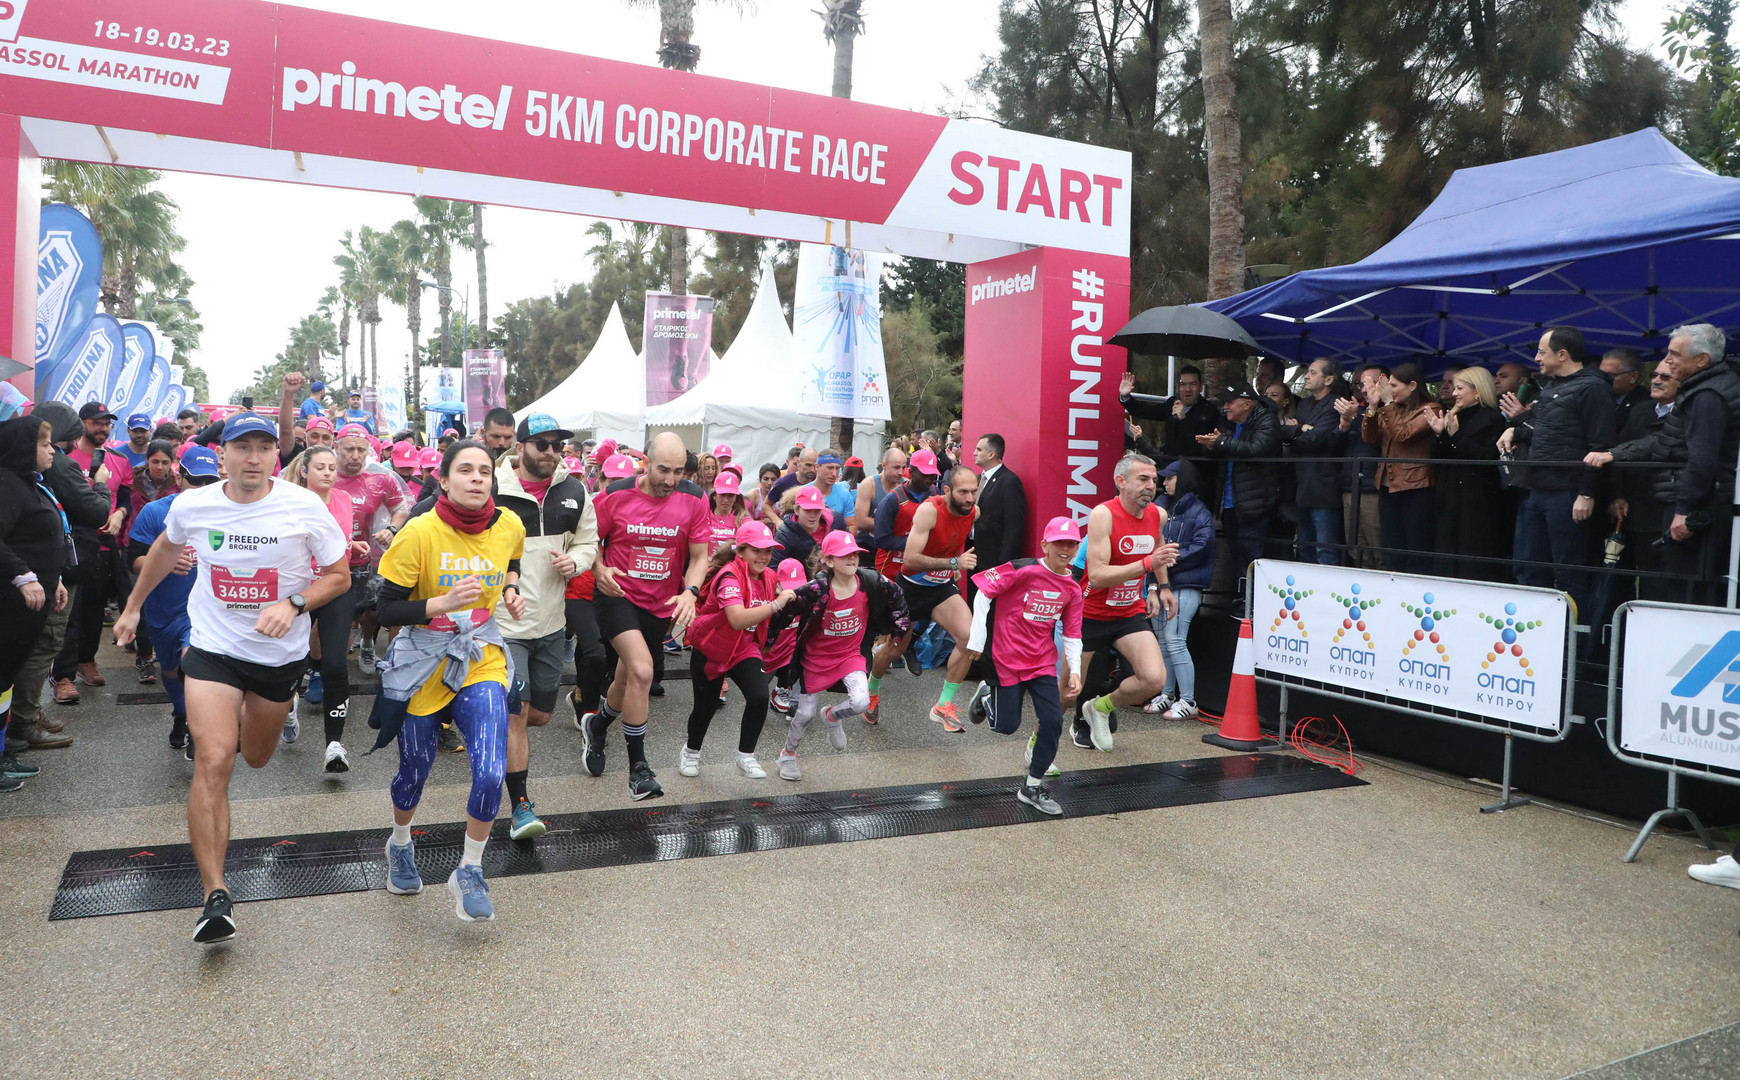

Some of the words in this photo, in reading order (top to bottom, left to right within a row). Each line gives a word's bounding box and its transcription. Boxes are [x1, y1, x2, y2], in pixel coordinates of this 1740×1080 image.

[94, 20, 230, 57] 18-19.03.23
[78, 58, 200, 90] MARATHON
[282, 61, 513, 131] primetel
[525, 90, 604, 145] 5KM
[615, 104, 803, 173] CORPORATE
[810, 134, 888, 185] RACE
[947, 151, 1122, 226] START
[971, 265, 1037, 305] primetel
[653, 307, 702, 320] primetel
[829, 371, 852, 380] OPAP
[626, 522, 680, 537] primetel
[228, 534, 278, 545] FREEDOM
[228, 543, 258, 551] BROKER
[440, 552, 494, 571] Endo
[635, 559, 669, 571] 36661
[218, 585, 270, 600] 34894
[226, 602, 261, 610] primetel
[830, 617, 860, 631] 30322
[1267, 652, 1308, 668] ΚΥΠΡΟΥ
[1329, 664, 1375, 681] ΚΥΠΡΟΥ
[1398, 677, 1450, 696] ΚΥΠΡΟΥ
[1476, 692, 1534, 713] ΚΥΠΡΟΥ
